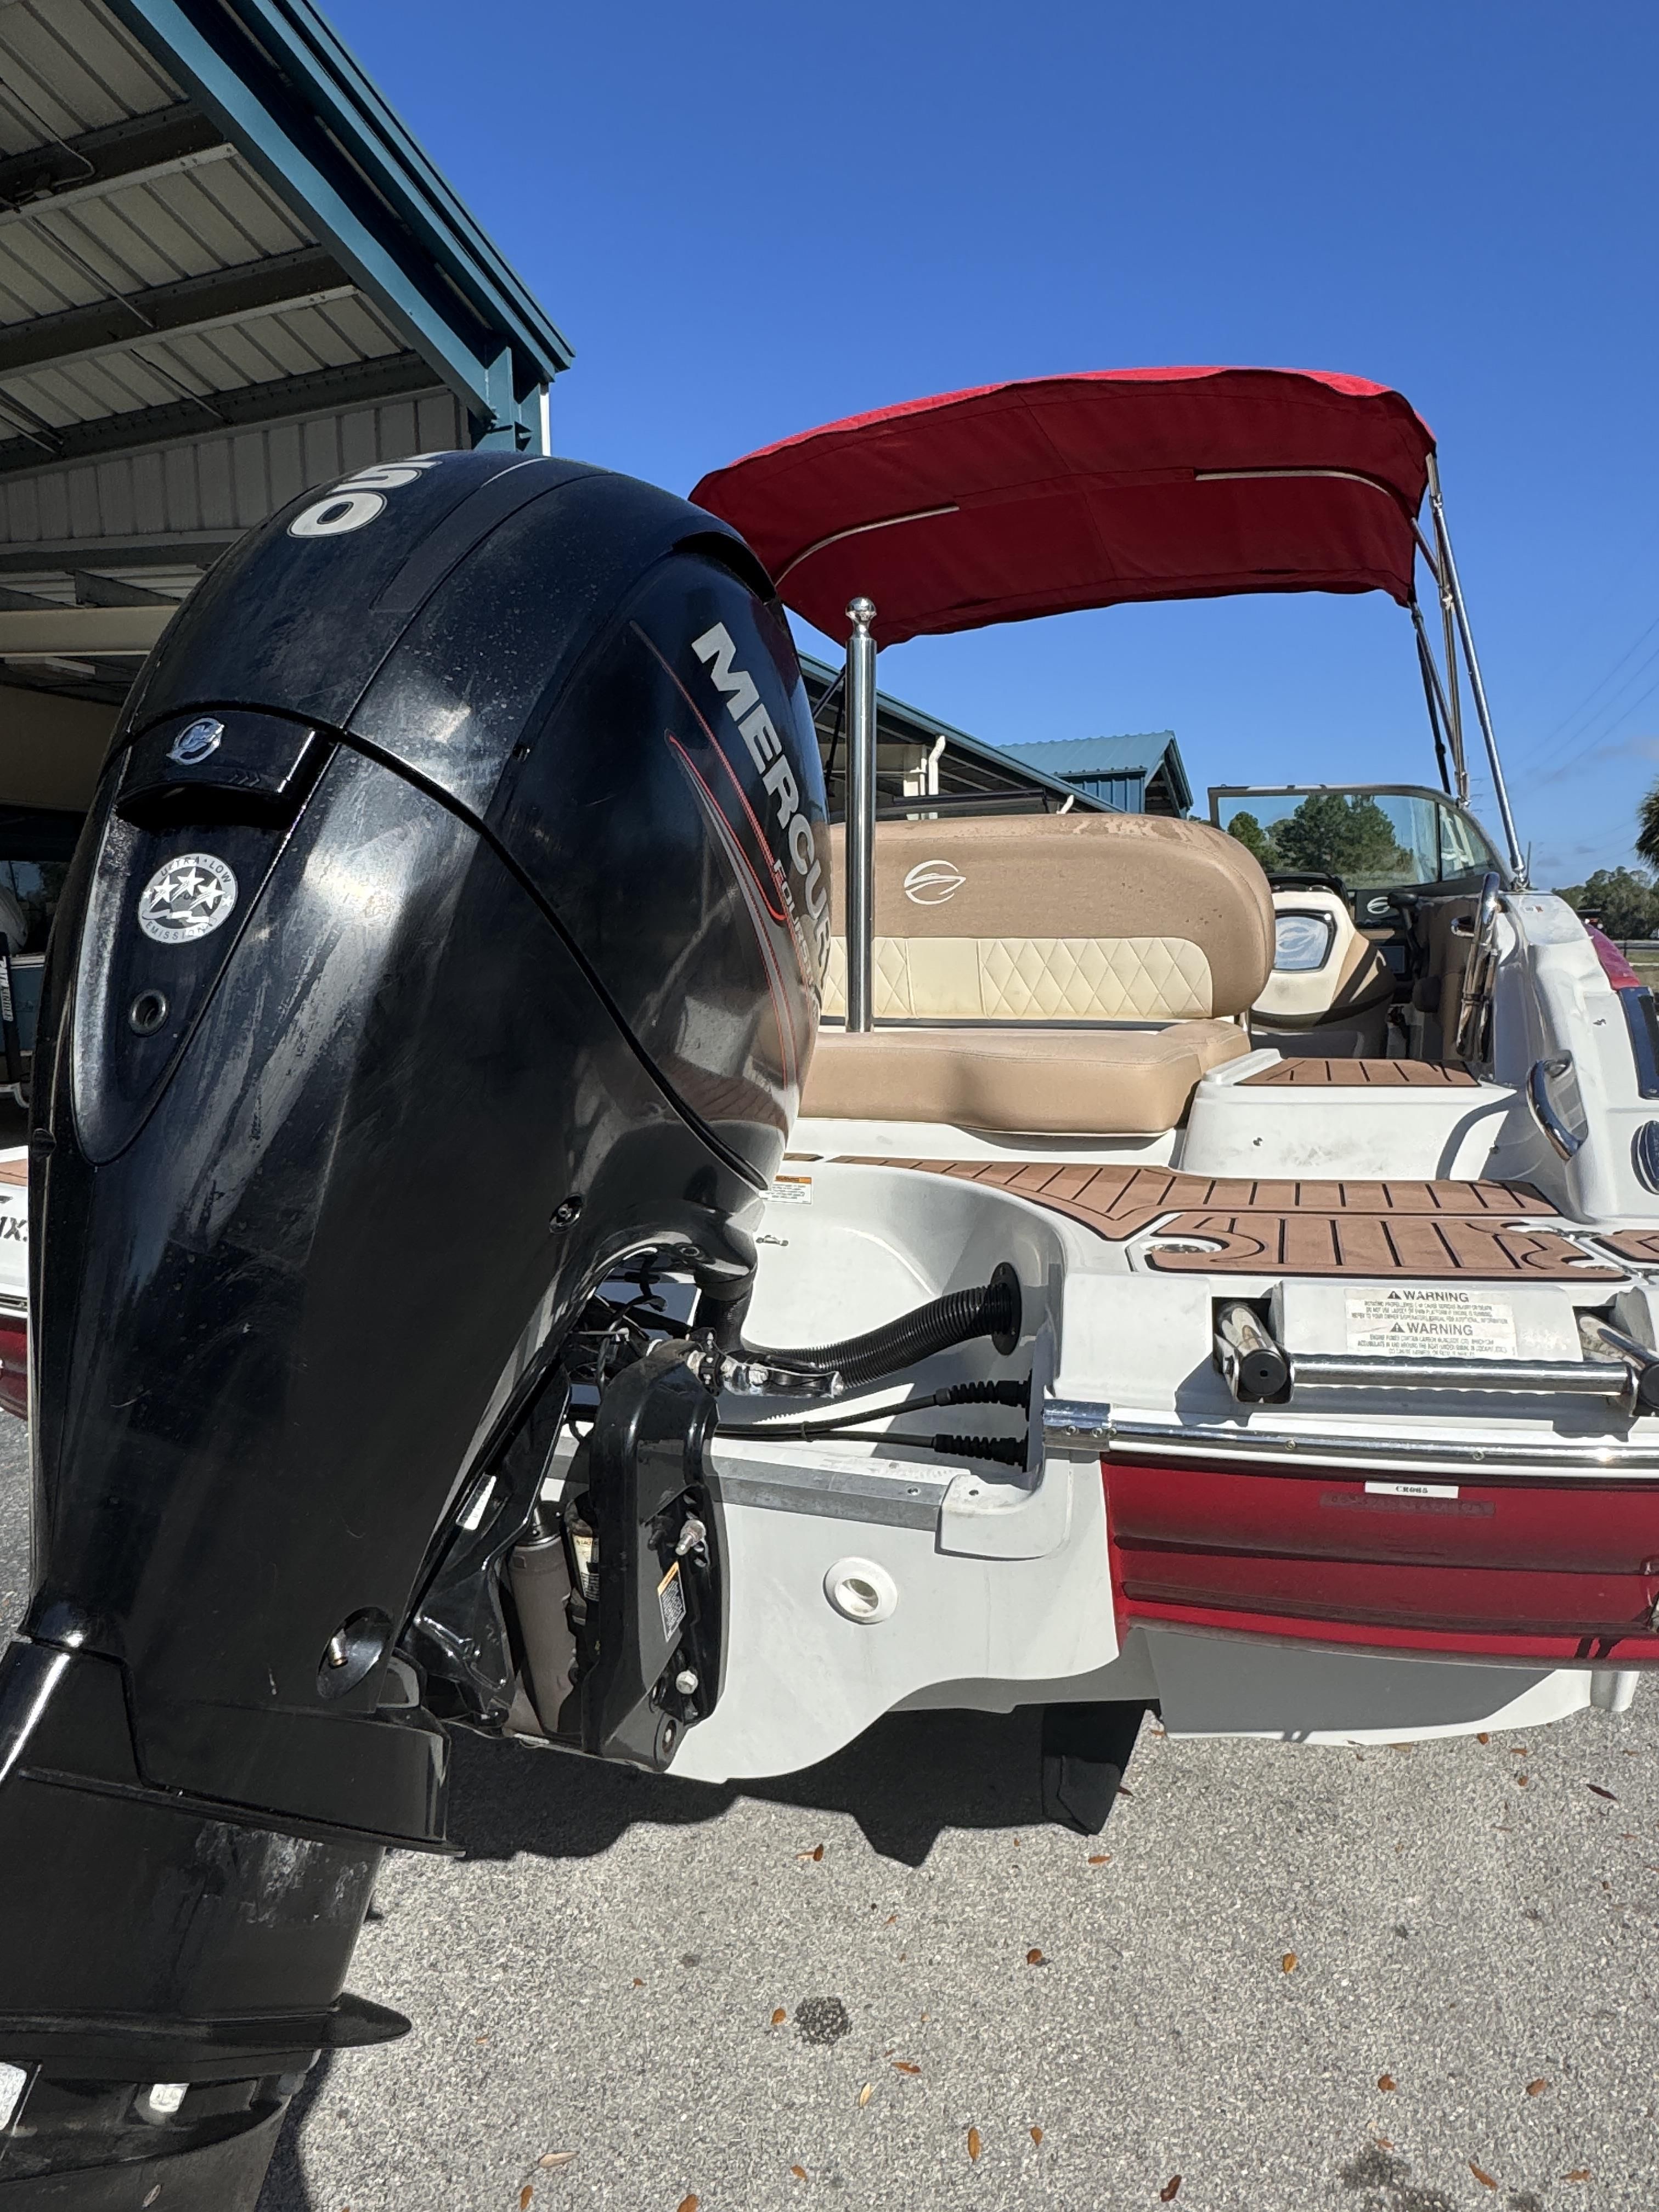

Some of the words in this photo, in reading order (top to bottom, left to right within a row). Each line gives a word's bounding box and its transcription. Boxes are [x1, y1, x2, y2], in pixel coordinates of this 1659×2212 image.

[691, 622, 830, 989] MERCUR
[161, 856, 200, 877] ULTRA
[209, 861, 232, 883] LOW
[1403, 1290, 1469, 1302] WARNING
[1407, 1322, 1473, 1336] WARNING
